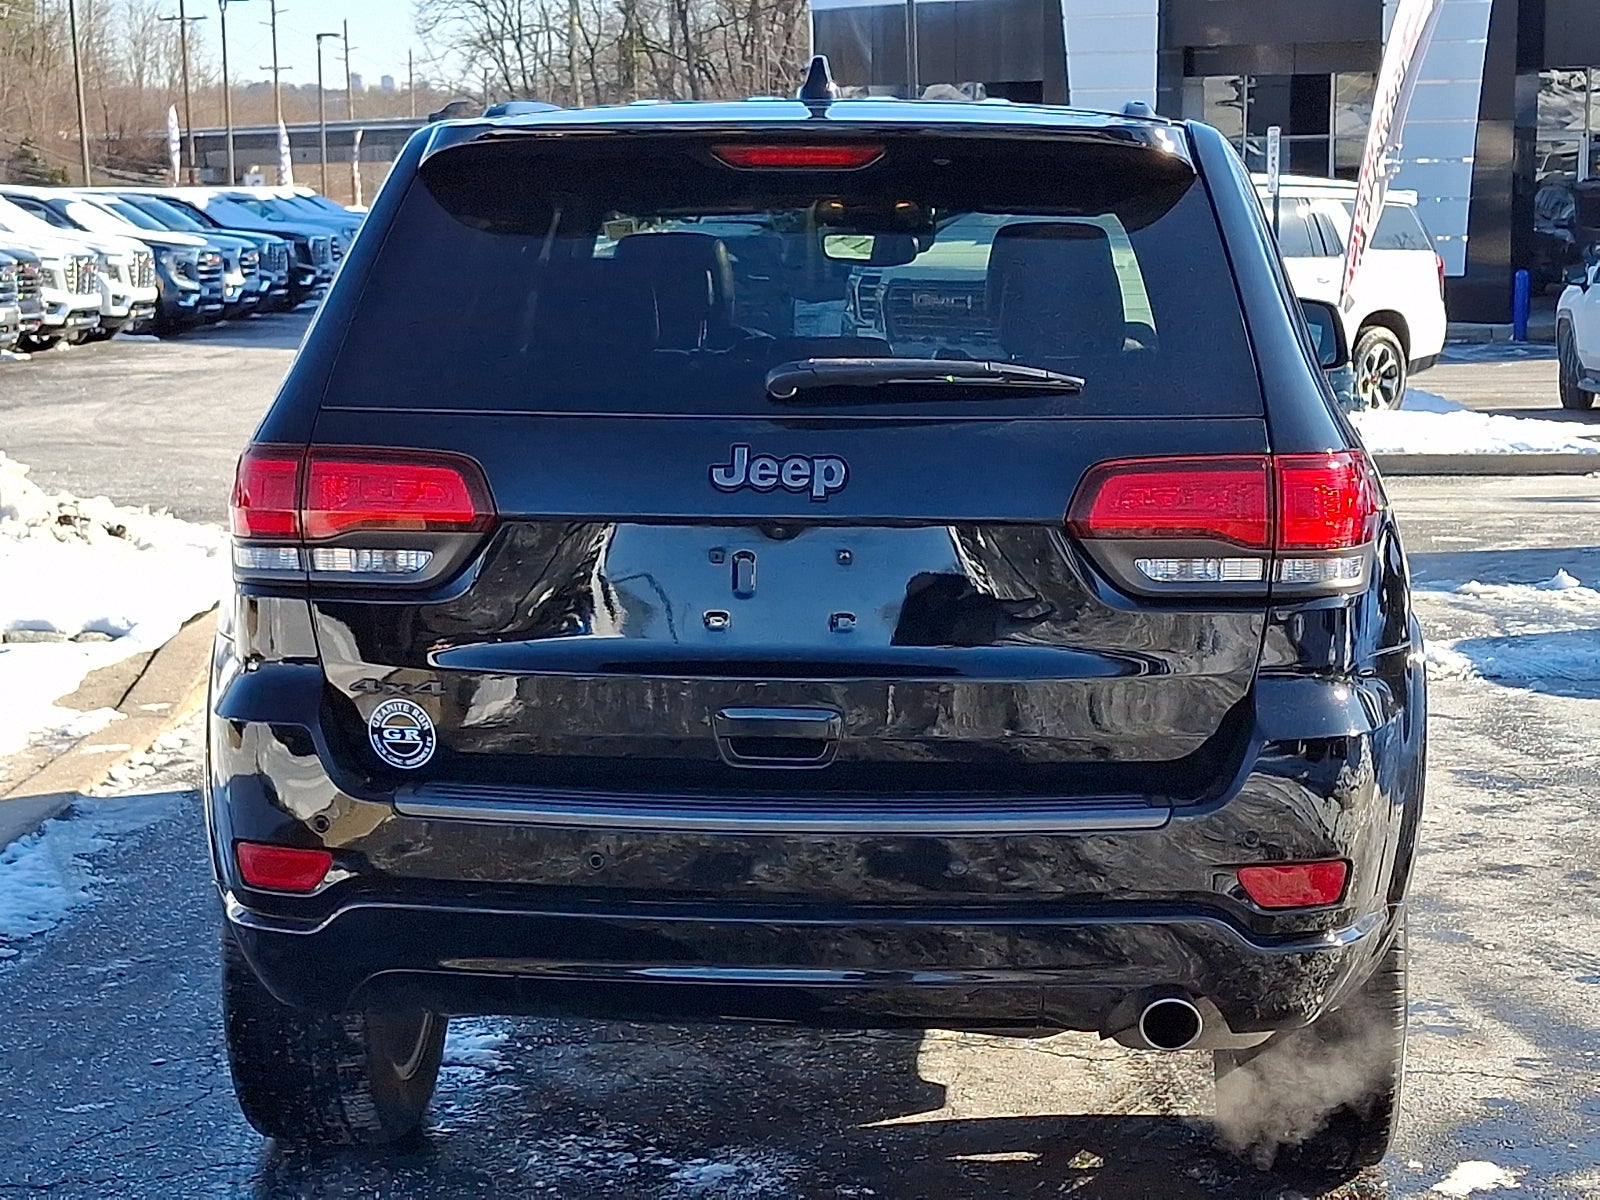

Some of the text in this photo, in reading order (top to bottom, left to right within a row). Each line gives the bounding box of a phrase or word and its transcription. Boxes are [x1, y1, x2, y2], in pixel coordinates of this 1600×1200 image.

[710, 444, 848, 500] Jeep
[372, 703, 410, 728] GRANITE
[382, 729, 421, 741] GR
